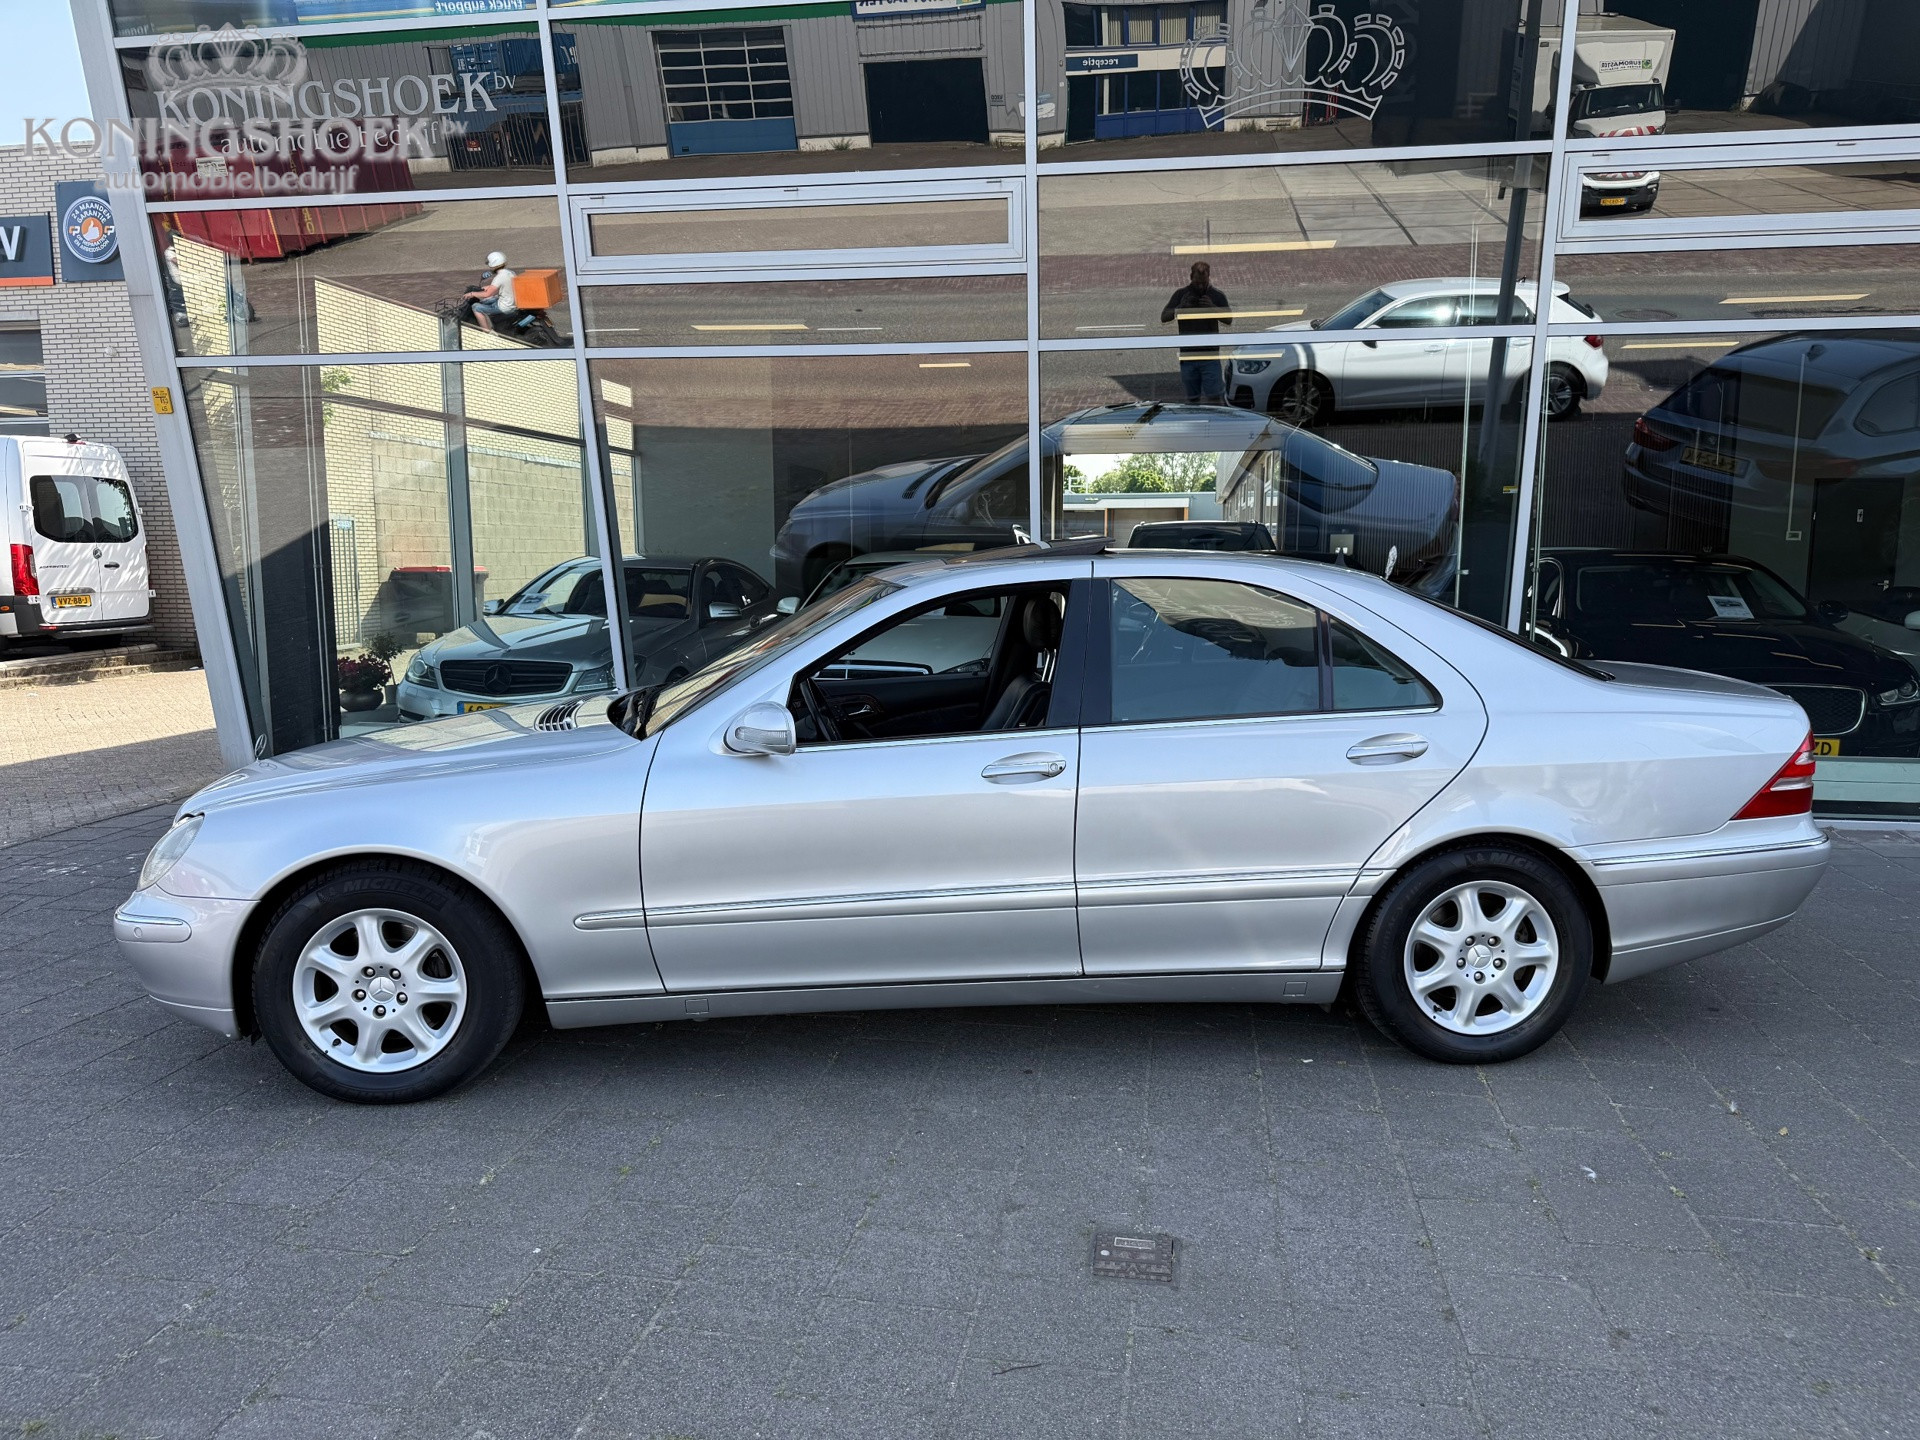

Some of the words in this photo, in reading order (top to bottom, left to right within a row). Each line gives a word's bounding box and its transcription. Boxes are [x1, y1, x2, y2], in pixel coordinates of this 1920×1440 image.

[151, 72, 498, 129] KONINGSHOEK
[494, 73, 517, 90] bv
[71, 209, 80, 219] 24
[79, 202, 112, 220] MAANDEN
[77, 209, 107, 224] GARANTIE
